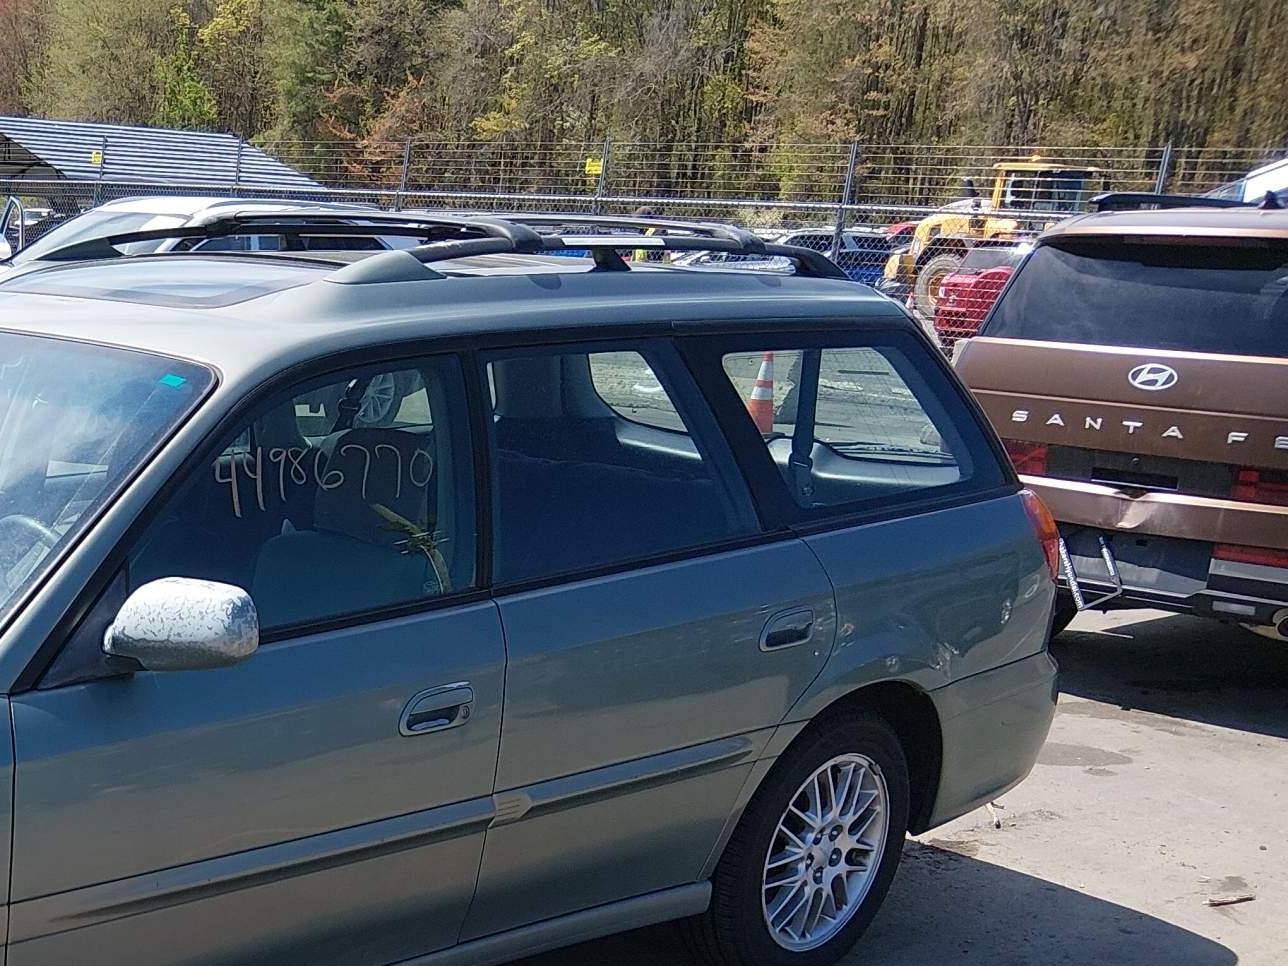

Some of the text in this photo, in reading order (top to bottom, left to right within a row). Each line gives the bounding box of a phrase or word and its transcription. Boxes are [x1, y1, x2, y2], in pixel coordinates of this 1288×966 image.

[1011, 409, 1288, 450] SANTA FE
[214, 443, 434, 519] 44986770
